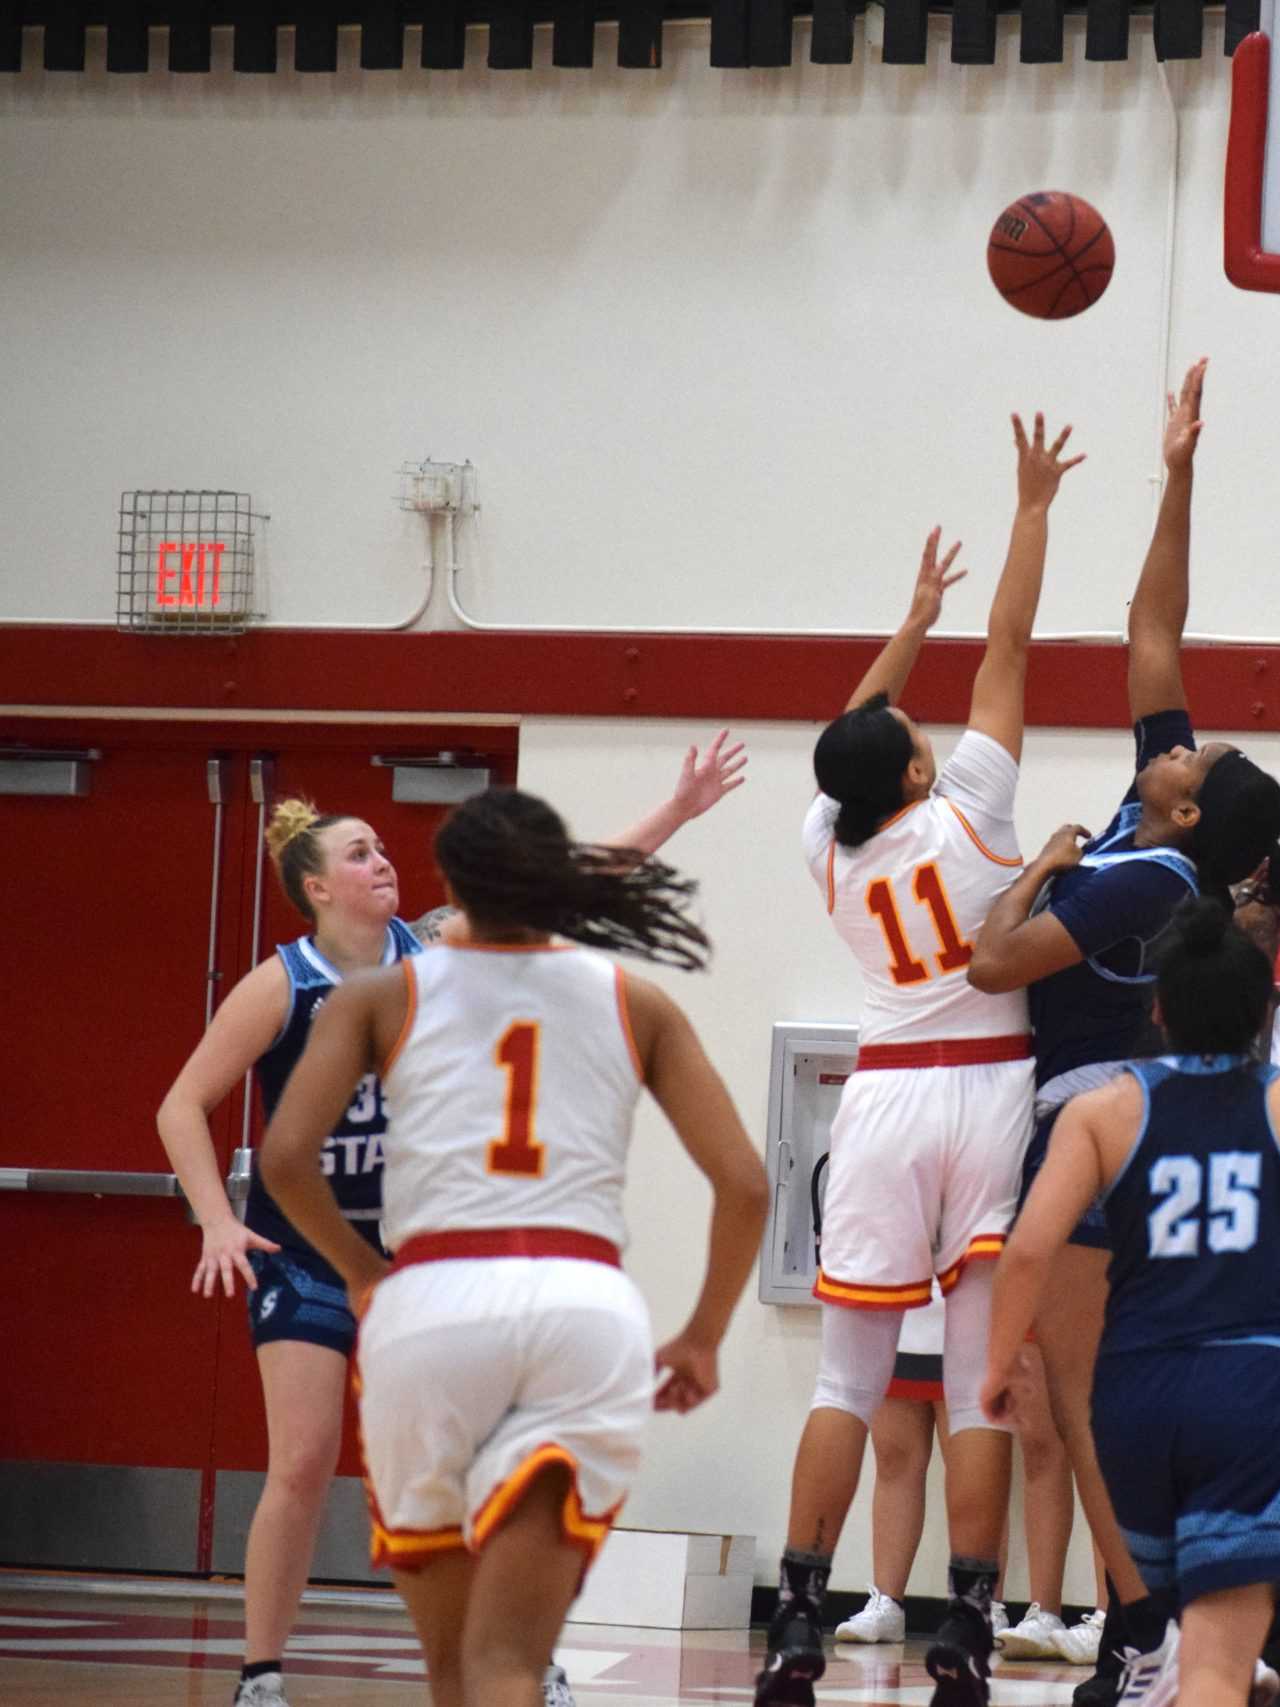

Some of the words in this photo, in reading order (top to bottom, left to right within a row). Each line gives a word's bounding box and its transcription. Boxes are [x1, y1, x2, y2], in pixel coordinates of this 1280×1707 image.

[157, 543, 225, 608] EXIT
[864, 860, 976, 987] 11
[484, 1019, 546, 1181] 1
[1148, 1151, 1263, 1258] 25
